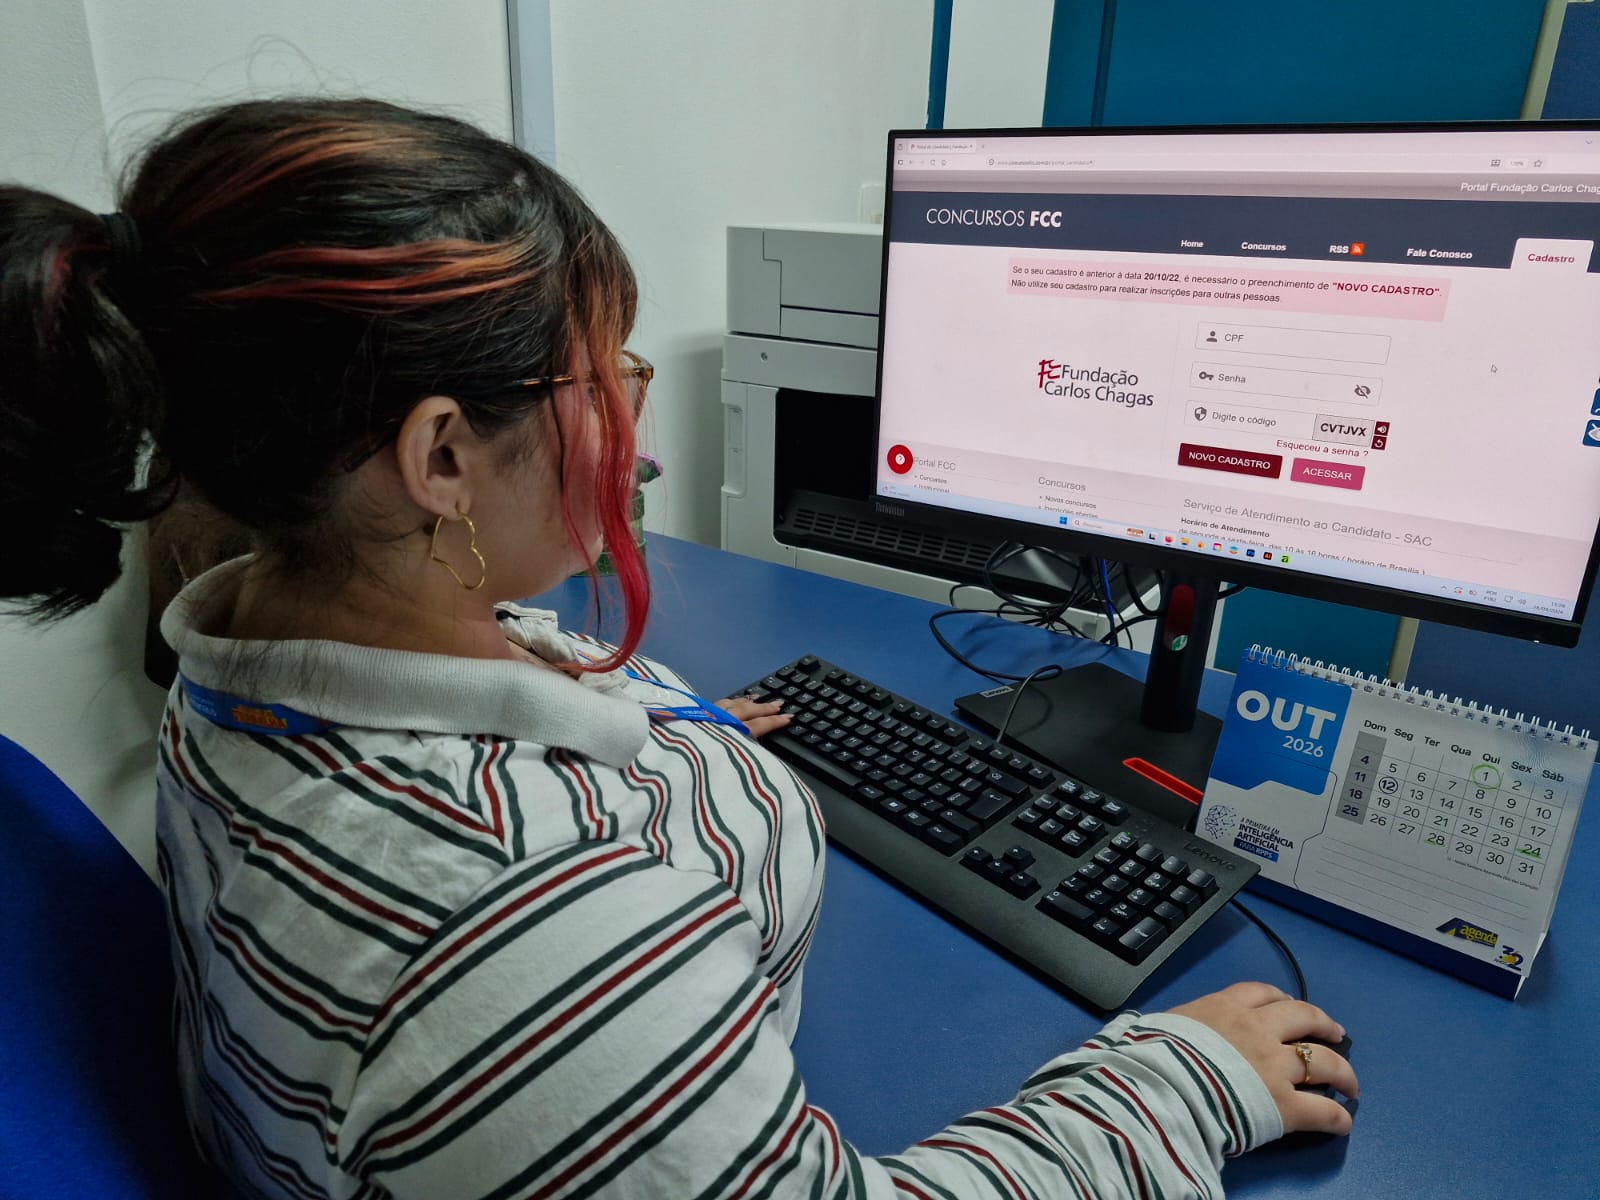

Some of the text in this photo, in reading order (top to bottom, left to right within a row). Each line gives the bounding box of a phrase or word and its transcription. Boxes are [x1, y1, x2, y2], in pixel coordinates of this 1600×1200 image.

[1460, 182, 1488, 191] Portal
[1490, 182, 1538, 194] Fundação
[1541, 183, 1573, 193] Carlos
[926, 208, 1062, 228] CONCURSOS FCC
[1180, 240, 1204, 248] Home
[1241, 242, 1287, 251] Concursos
[1329, 245, 1349, 254] RSS
[1407, 248, 1473, 260] Fale Conosco
[1528, 253, 1575, 263] Cadastro
[1012, 266, 1022, 274] Se
[1046, 267, 1078, 276] cadastro
[1086, 270, 1115, 278] anterior
[1125, 271, 1142, 280] data
[1184, 274, 1189, 282] é
[1191, 276, 1238, 285] necessário
[1248, 278, 1315, 290] preenchimento
[1317, 282, 1329, 290] de
[1332, 282, 1368, 292] "NOVO
[1011, 279, 1026, 288] Não
[1027, 280, 1048, 289] utilize
[1065, 282, 1098, 291] cadastro
[1099, 285, 1117, 293] para
[1119, 285, 1148, 294] realizar
[1150, 287, 1191, 298] inscrições
[1192, 290, 1212, 299] para
[1213, 292, 1241, 300] outras
[1224, 334, 1244, 343] CPF
[1061, 364, 1139, 388] Fundação
[1218, 373, 1246, 383] Senha
[1044, 380, 1154, 408] Carlos Chagas
[1212, 411, 1237, 424] Digite
[1247, 416, 1276, 427] código
[1320, 422, 1366, 437] CVTJVX
[1276, 440, 1320, 453] Esqueceu
[1331, 447, 1360, 457] senha
[1363, 450, 1369, 458] ?
[914, 456, 956, 471] Portal FCC
[1189, 452, 1271, 470] NOVO CADASTRO
[1303, 466, 1352, 480] ACESSAR
[1038, 476, 1086, 492] Concursos
[1065, 499, 1096, 509] concursos
[1181, 517, 1208, 527] Horário
[1221, 524, 1270, 538] Atendimento
[1183, 498, 1222, 514] Serviço
[1225, 506, 1238, 515] de
[1241, 508, 1310, 527] Atendimento
[1313, 521, 1328, 529] ao
[1332, 522, 1391, 540] Candidato
[1403, 533, 1432, 547] SAC
[1236, 690, 1336, 740] OUT
[1282, 736, 1325, 758] 2026
[1364, 720, 1564, 783] Dom Seg Ter Qua Qui Sex Sáb
[1360, 755, 1552, 820] 4 5 6 7 8 9 10
[1483, 772, 1554, 800] 1 2 3
[1355, 772, 1546, 838] 11 12 13 14 15 16 17
[1349, 788, 1541, 857] 18 19 20 21 22 23 24
[1237, 832, 1280, 852] ARTIFICIAL
[1239, 824, 1294, 849] INTELIGÊNCIA
[1342, 804, 1359, 817] 25
[1369, 813, 1387, 826] 26
[1398, 823, 1415, 835] 27
[1427, 832, 1445, 846] 28
[1455, 842, 1474, 855] 29
[1486, 852, 1504, 865] 30
[1518, 862, 1534, 875] 31
[1184, 840, 1236, 871] Lenovo
[1460, 924, 1498, 944] agenda
